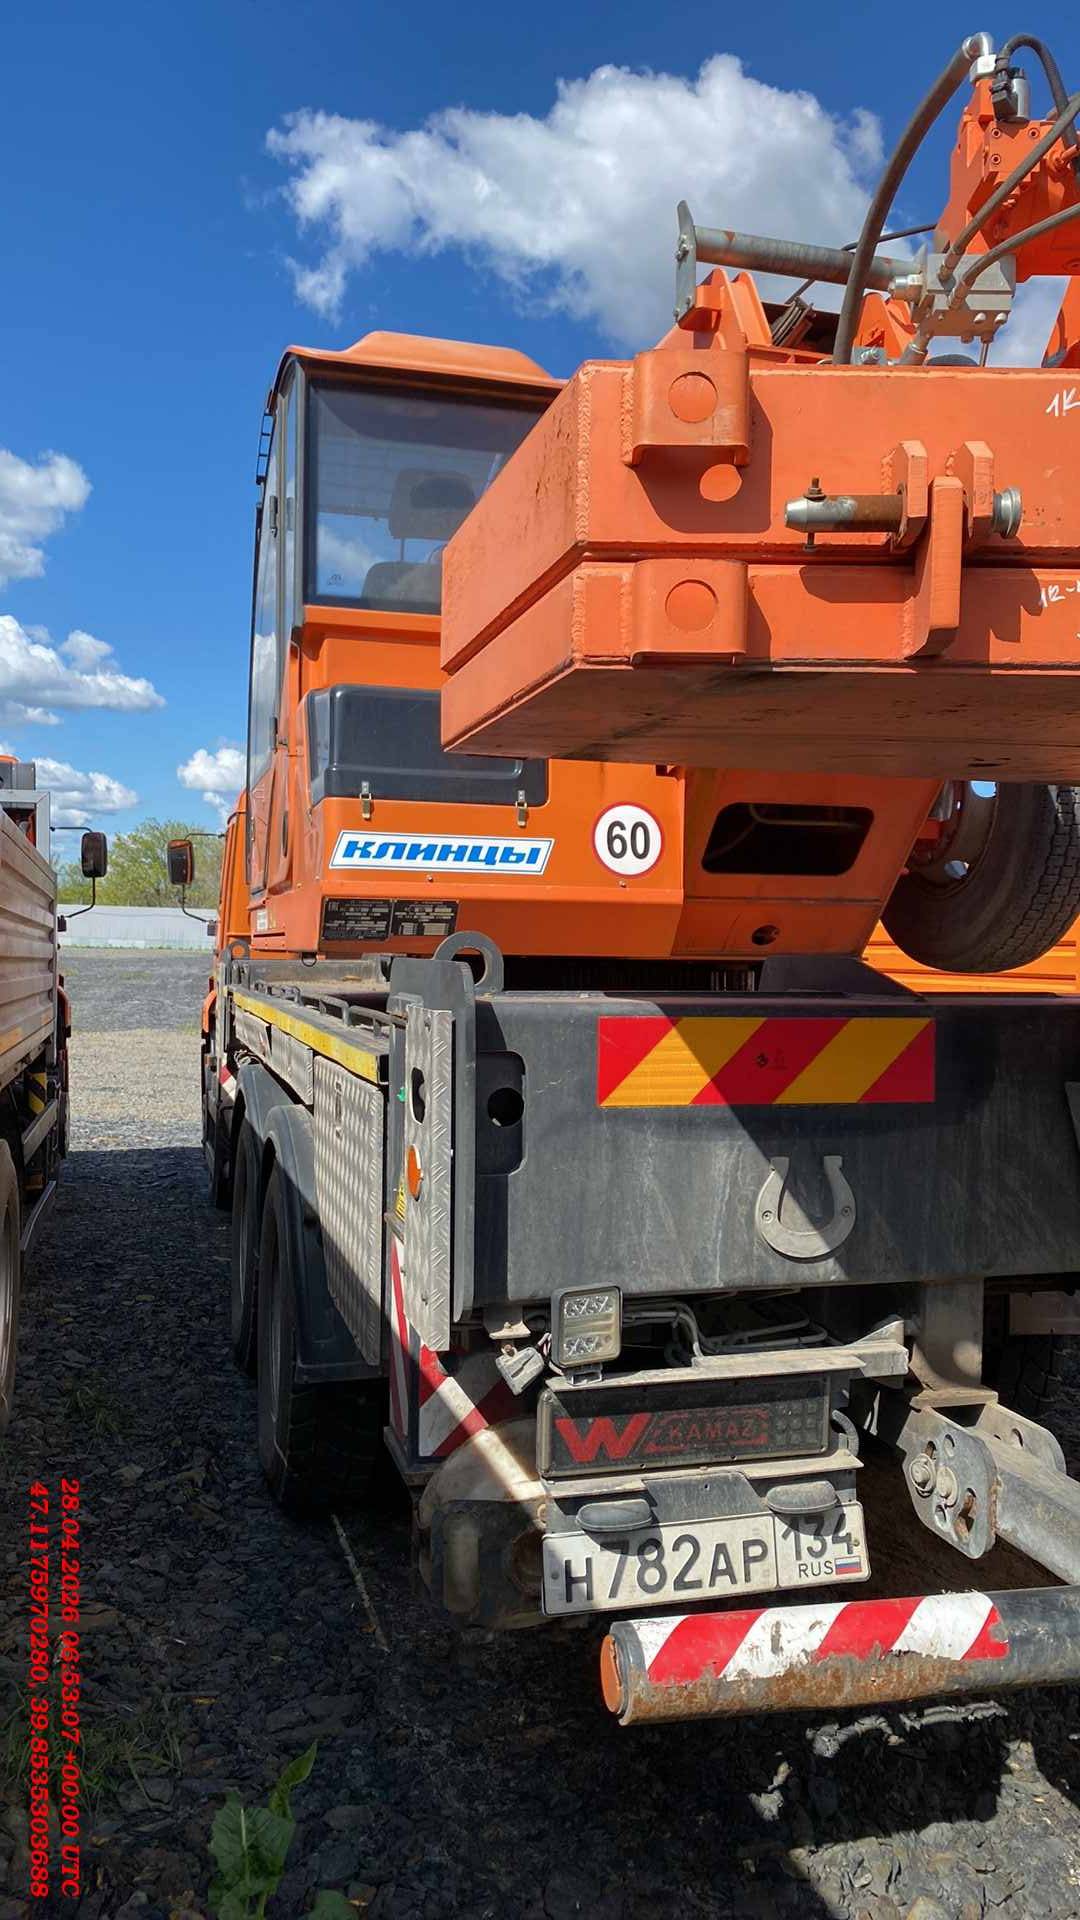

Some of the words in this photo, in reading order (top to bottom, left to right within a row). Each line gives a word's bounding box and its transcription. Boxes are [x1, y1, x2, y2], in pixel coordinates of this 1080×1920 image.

[342, 839, 541, 866] КЛИНЦЫ
[606, 820, 651, 860] 60
[781, 1512, 853, 1561] 134
[798, 1560, 834, 1578] RUS
